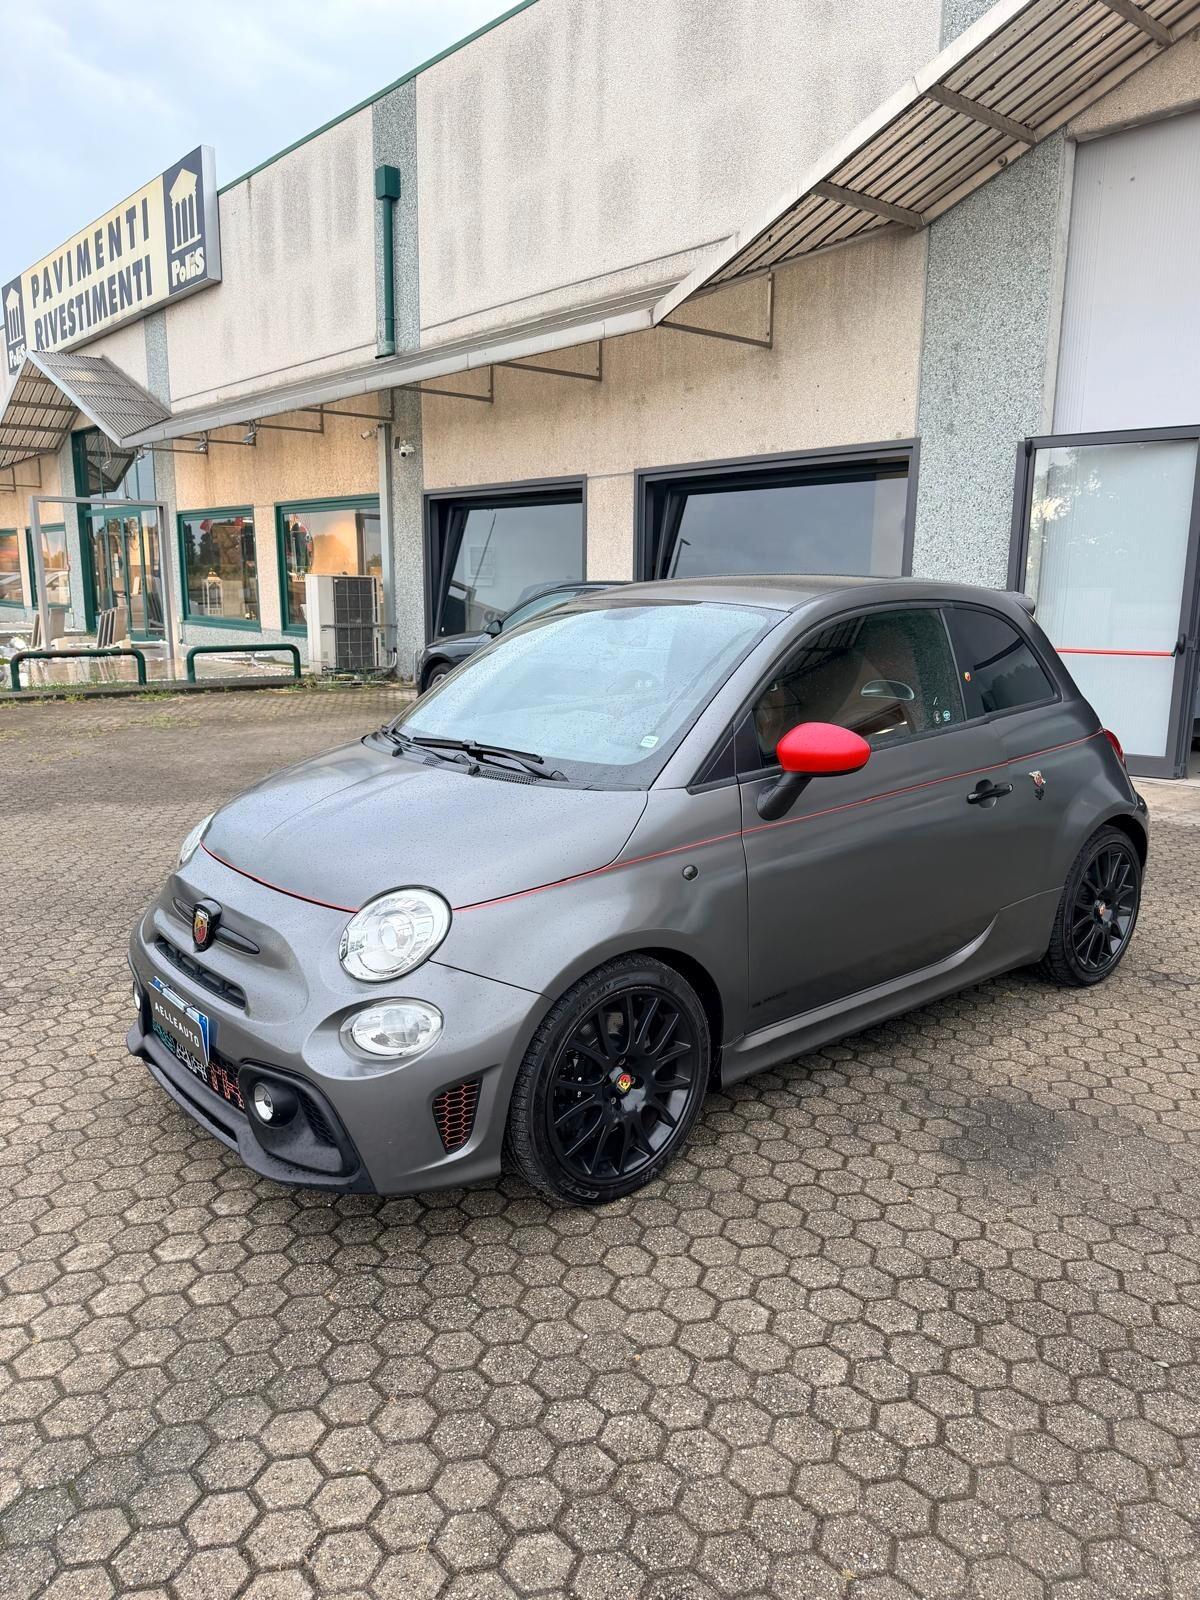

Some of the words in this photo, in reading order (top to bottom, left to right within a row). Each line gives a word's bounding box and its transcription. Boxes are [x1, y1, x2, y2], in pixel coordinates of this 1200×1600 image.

[31, 197, 150, 309] PAVIMENTI
[34, 254, 153, 351] RIVESTIMENTI
[154, 1002, 200, 1048] AELLEAUTO
